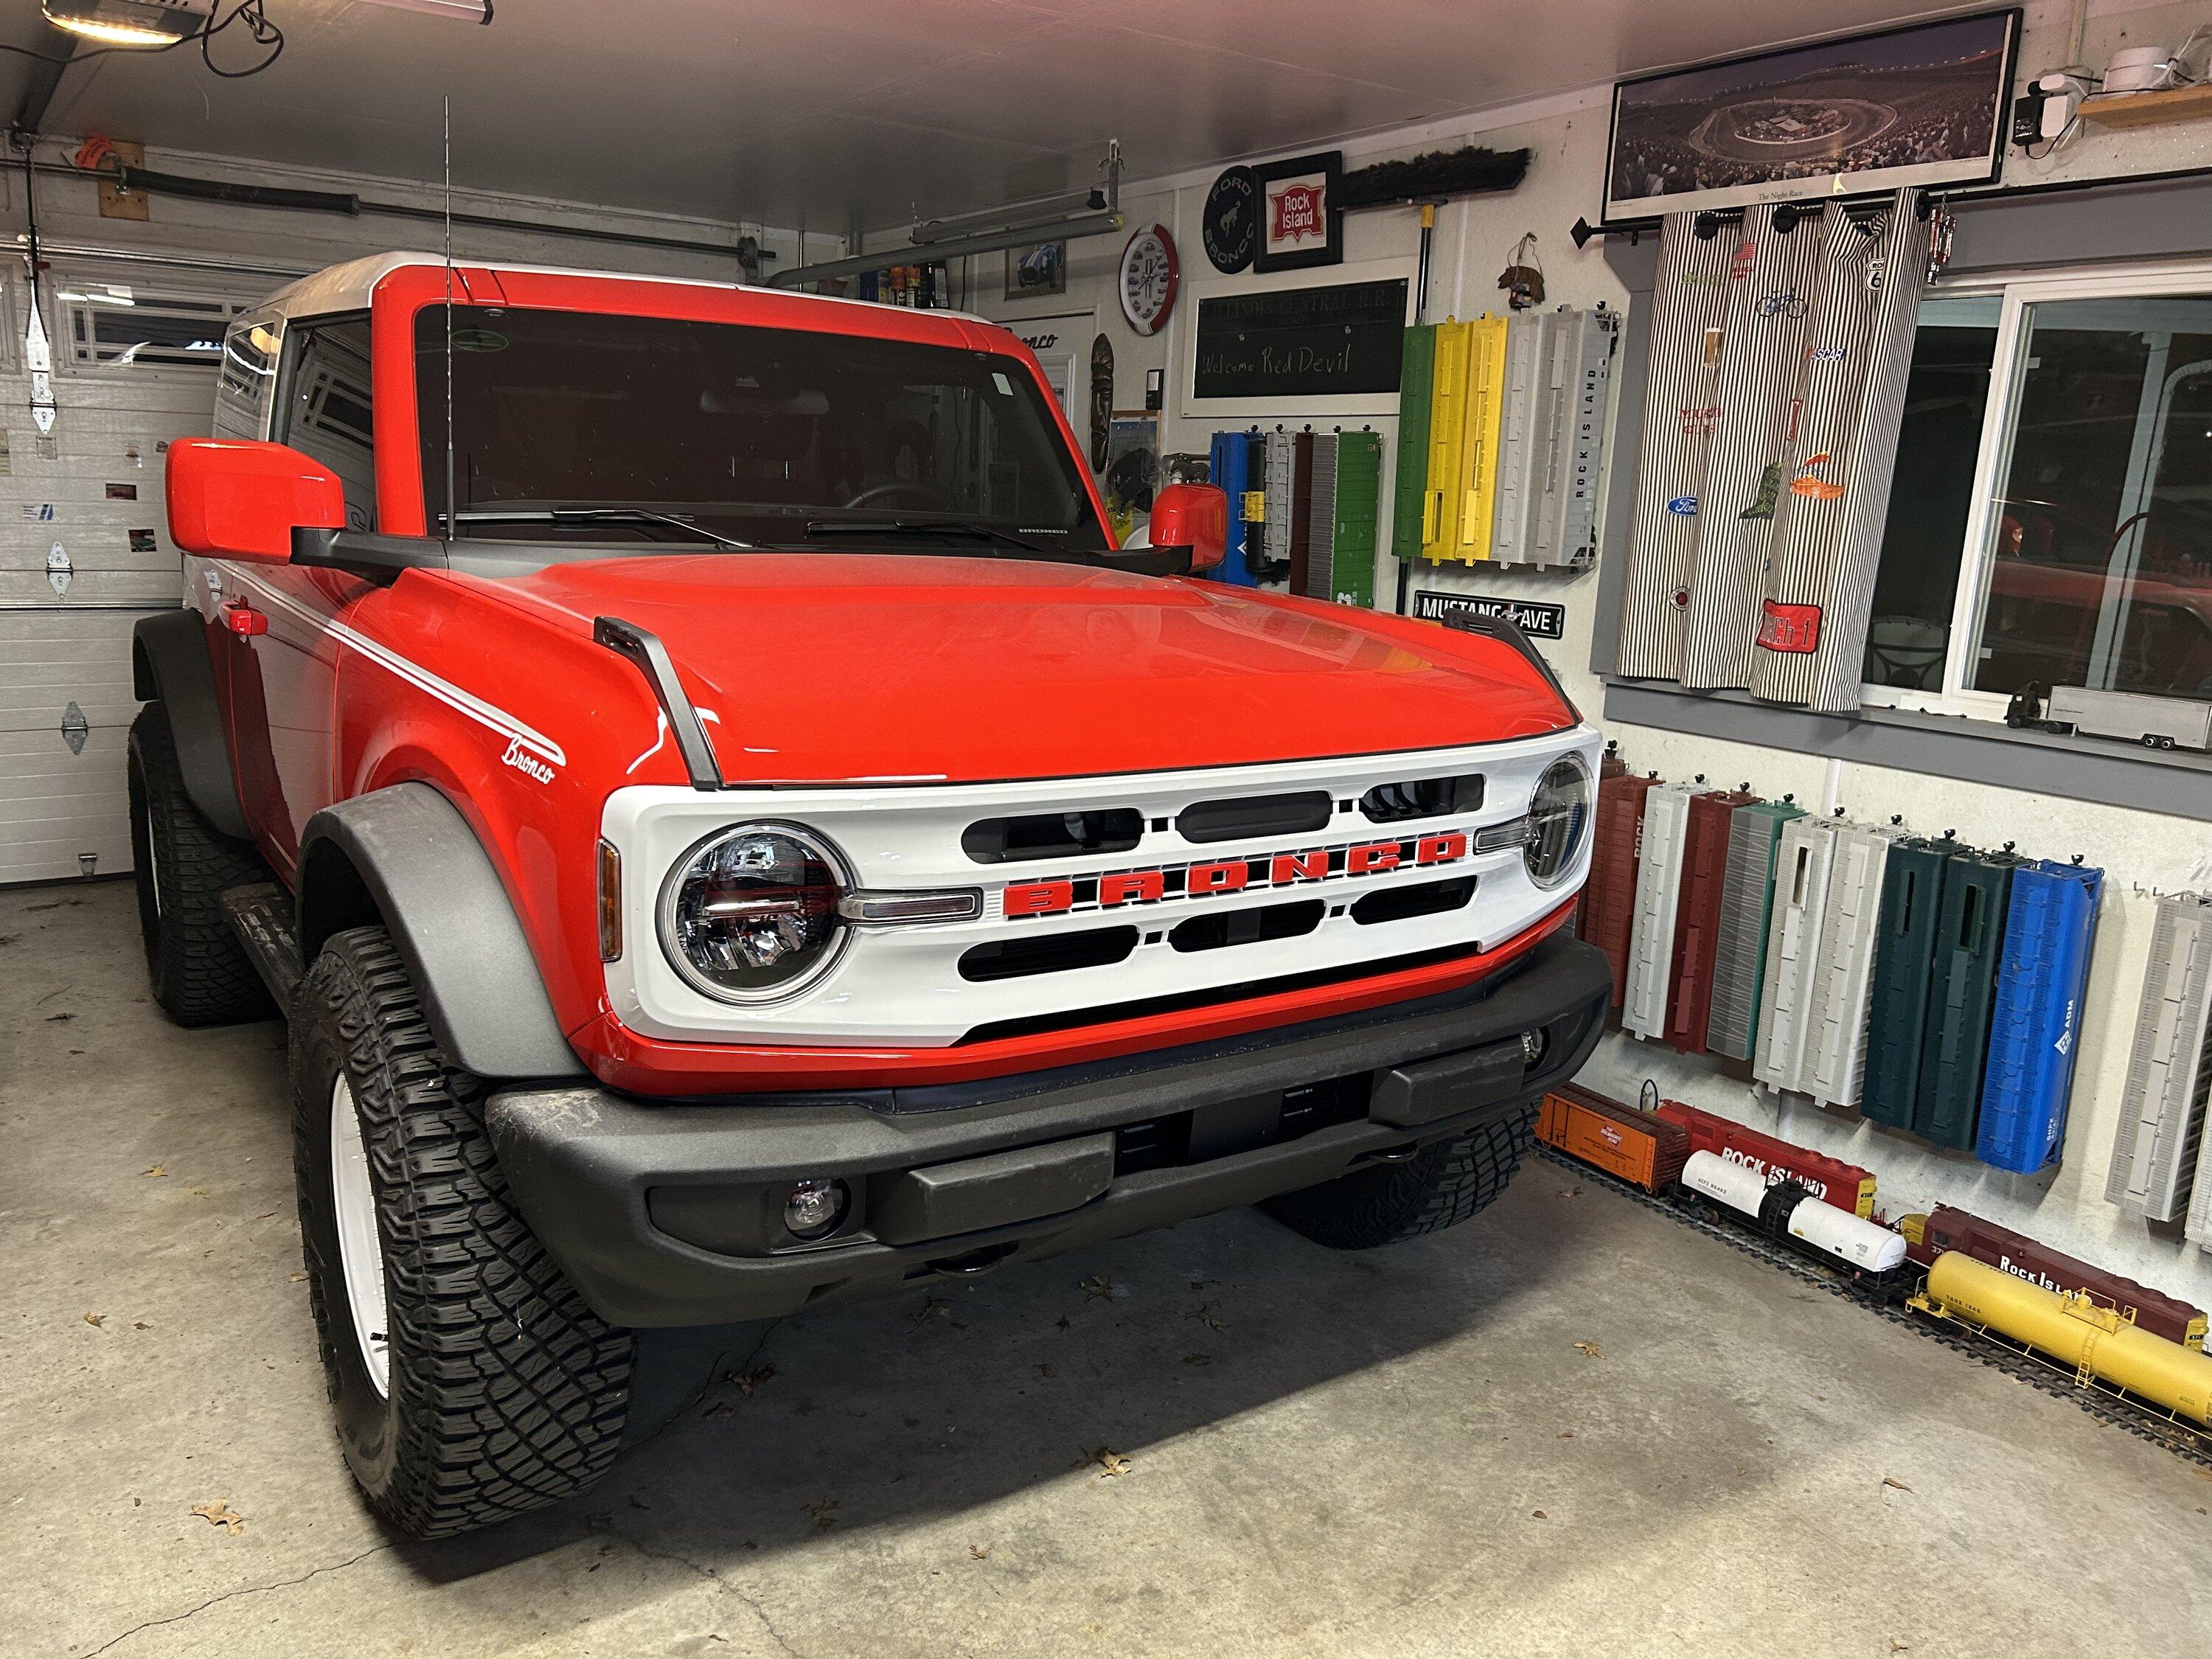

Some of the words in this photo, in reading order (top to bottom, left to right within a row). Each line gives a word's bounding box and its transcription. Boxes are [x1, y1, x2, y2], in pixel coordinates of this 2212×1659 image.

[1212, 177, 1252, 201] FORD
[1284, 192, 1310, 212] Rock
[1771, 191, 1787, 200] Night
[1282, 209, 1313, 229] Island
[1202, 353, 1254, 375] Welcome
[1262, 347, 1291, 374] Red
[1298, 343, 1352, 373] Devil
[1576, 451, 1588, 498] ROCK
[1582, 370, 1596, 441] ISLAND
[1520, 609, 1551, 630] AVE
[501, 732, 555, 785] Bronco
[1004, 832, 1467, 918] BRONCO
[2065, 999, 2074, 1028] ADM
[1722, 1147, 1766, 1175] ROCK
